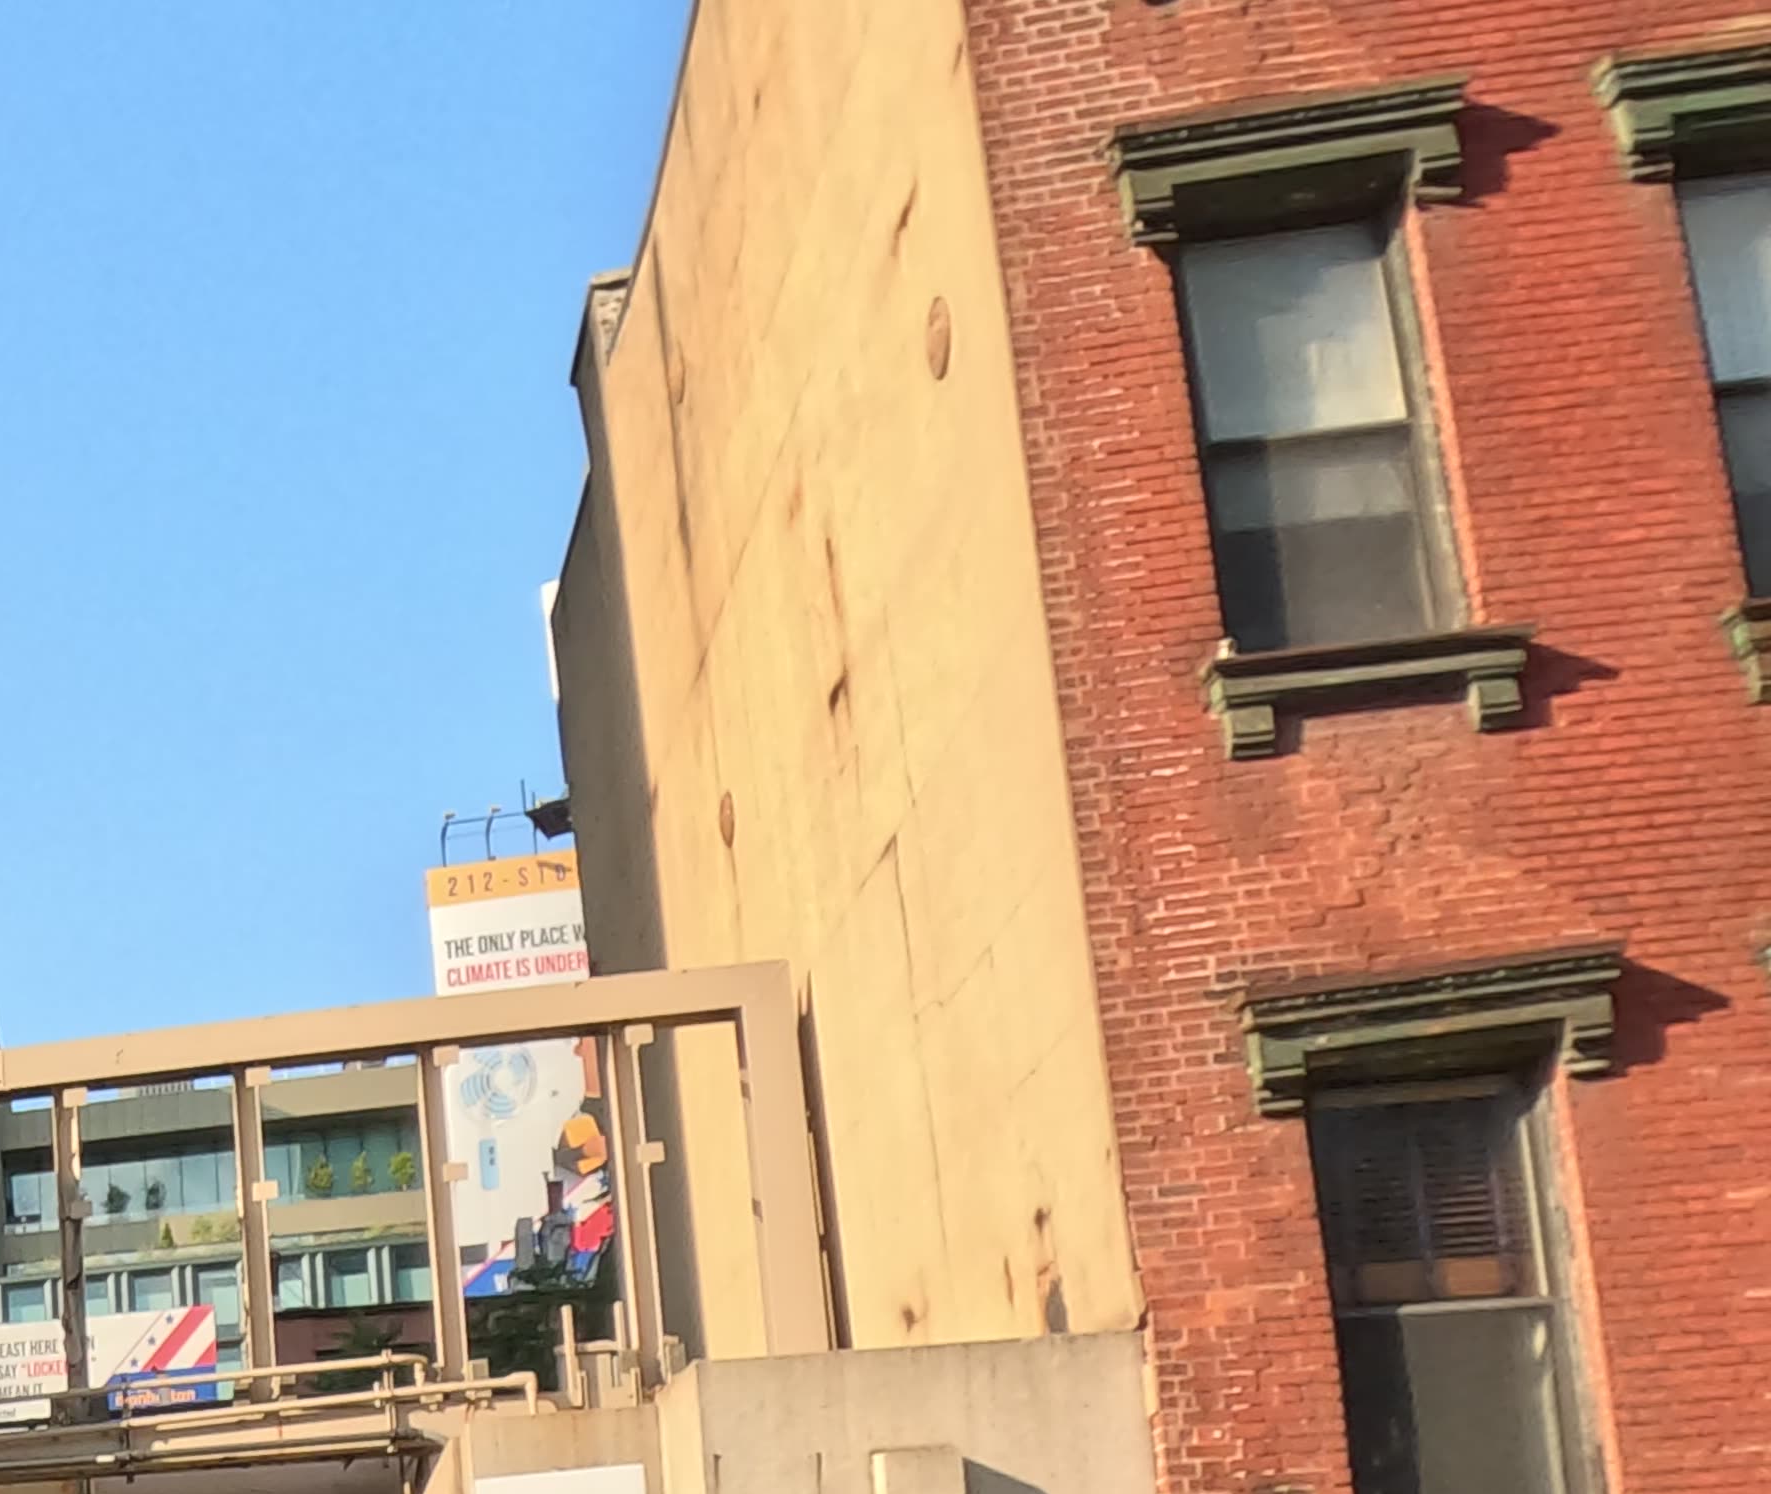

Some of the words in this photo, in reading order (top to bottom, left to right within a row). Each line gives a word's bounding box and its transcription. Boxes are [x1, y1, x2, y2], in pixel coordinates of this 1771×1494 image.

[444, 937, 474, 959] THE
[477, 931, 516, 954] ONLY
[519, 924, 569, 949] PLACE
[447, 960, 512, 987] CLIMATE
[516, 957, 530, 977] IS
[29, 1338, 60, 1356] HERE
